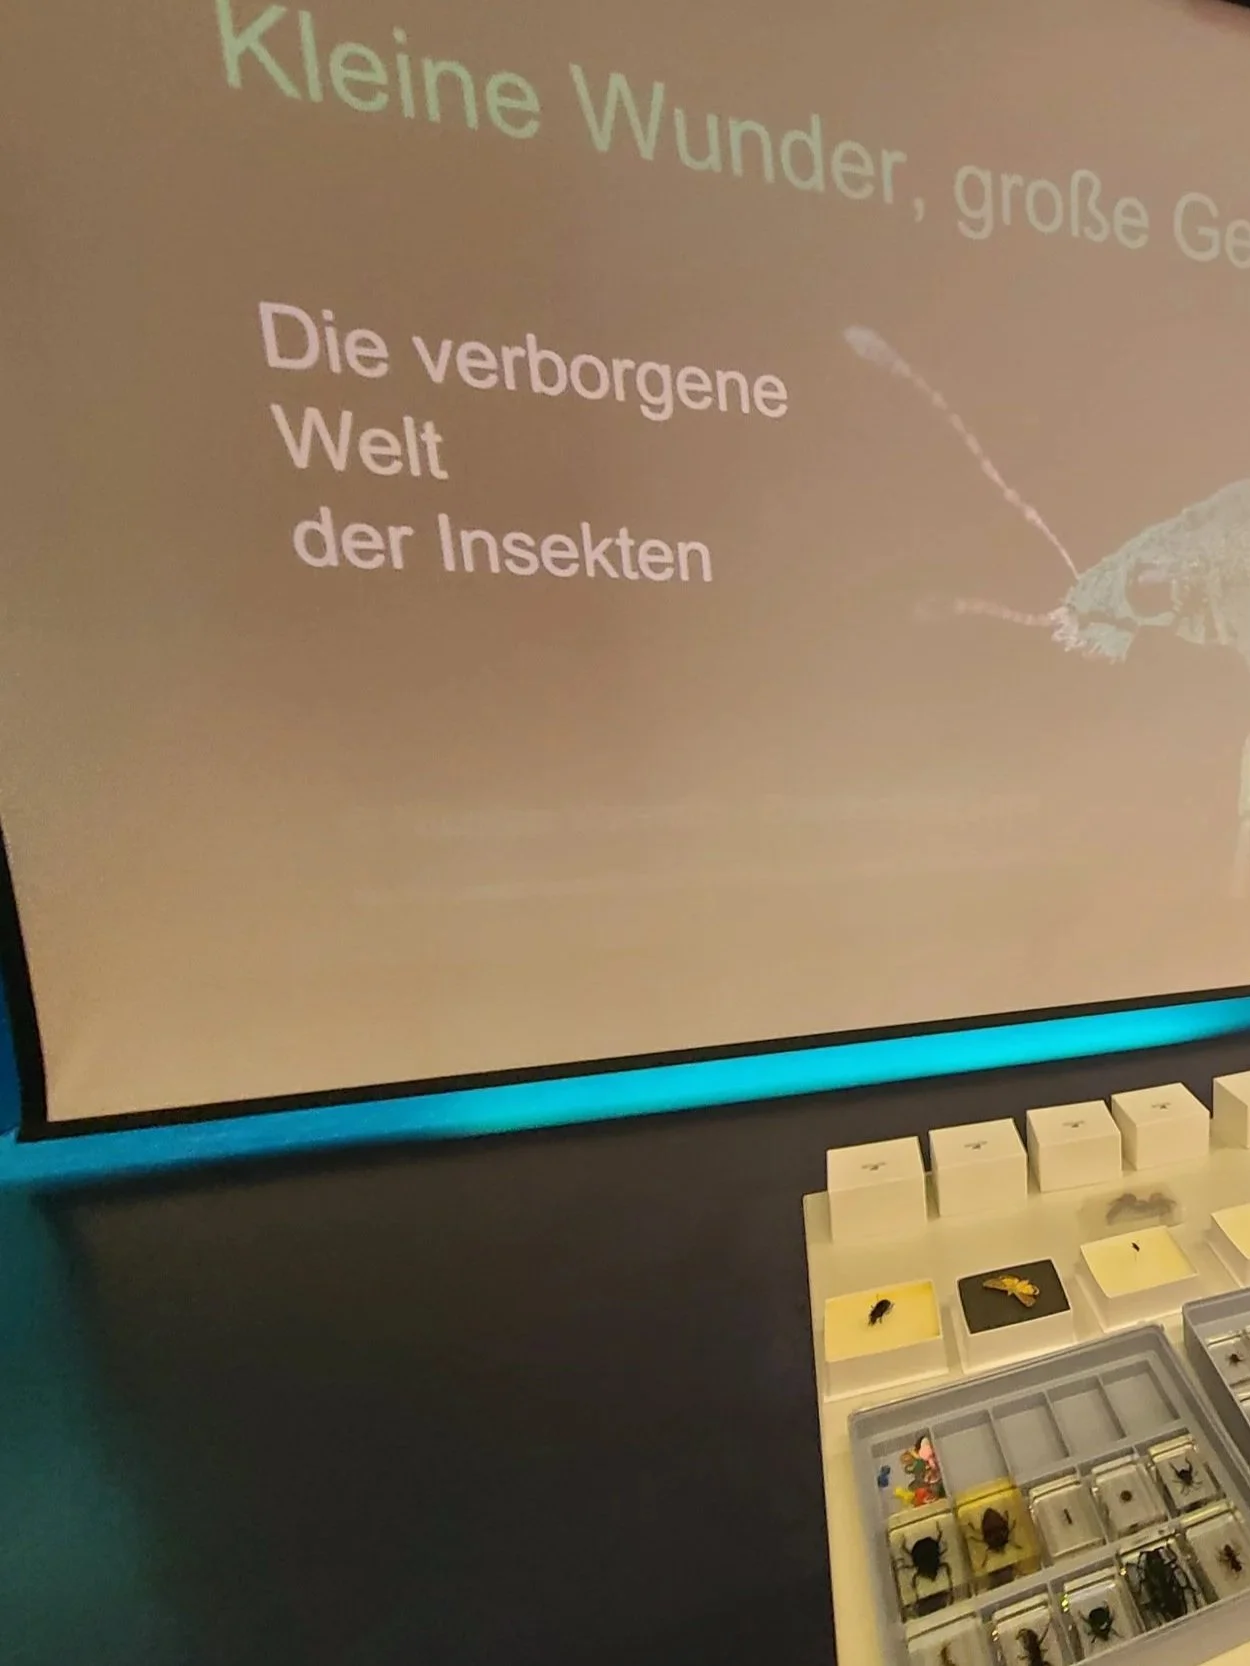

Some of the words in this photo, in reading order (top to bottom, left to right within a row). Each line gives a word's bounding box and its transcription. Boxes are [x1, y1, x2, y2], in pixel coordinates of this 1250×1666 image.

[215, 0, 542, 139] Kleine
[568, 62, 926, 223] Wunder,
[953, 164, 1150, 249] große
[258, 301, 390, 379] Die
[411, 332, 789, 422] verborgene
[270, 403, 449, 480] Welt
[292, 506, 414, 569] der
[437, 512, 713, 583] Insekten
